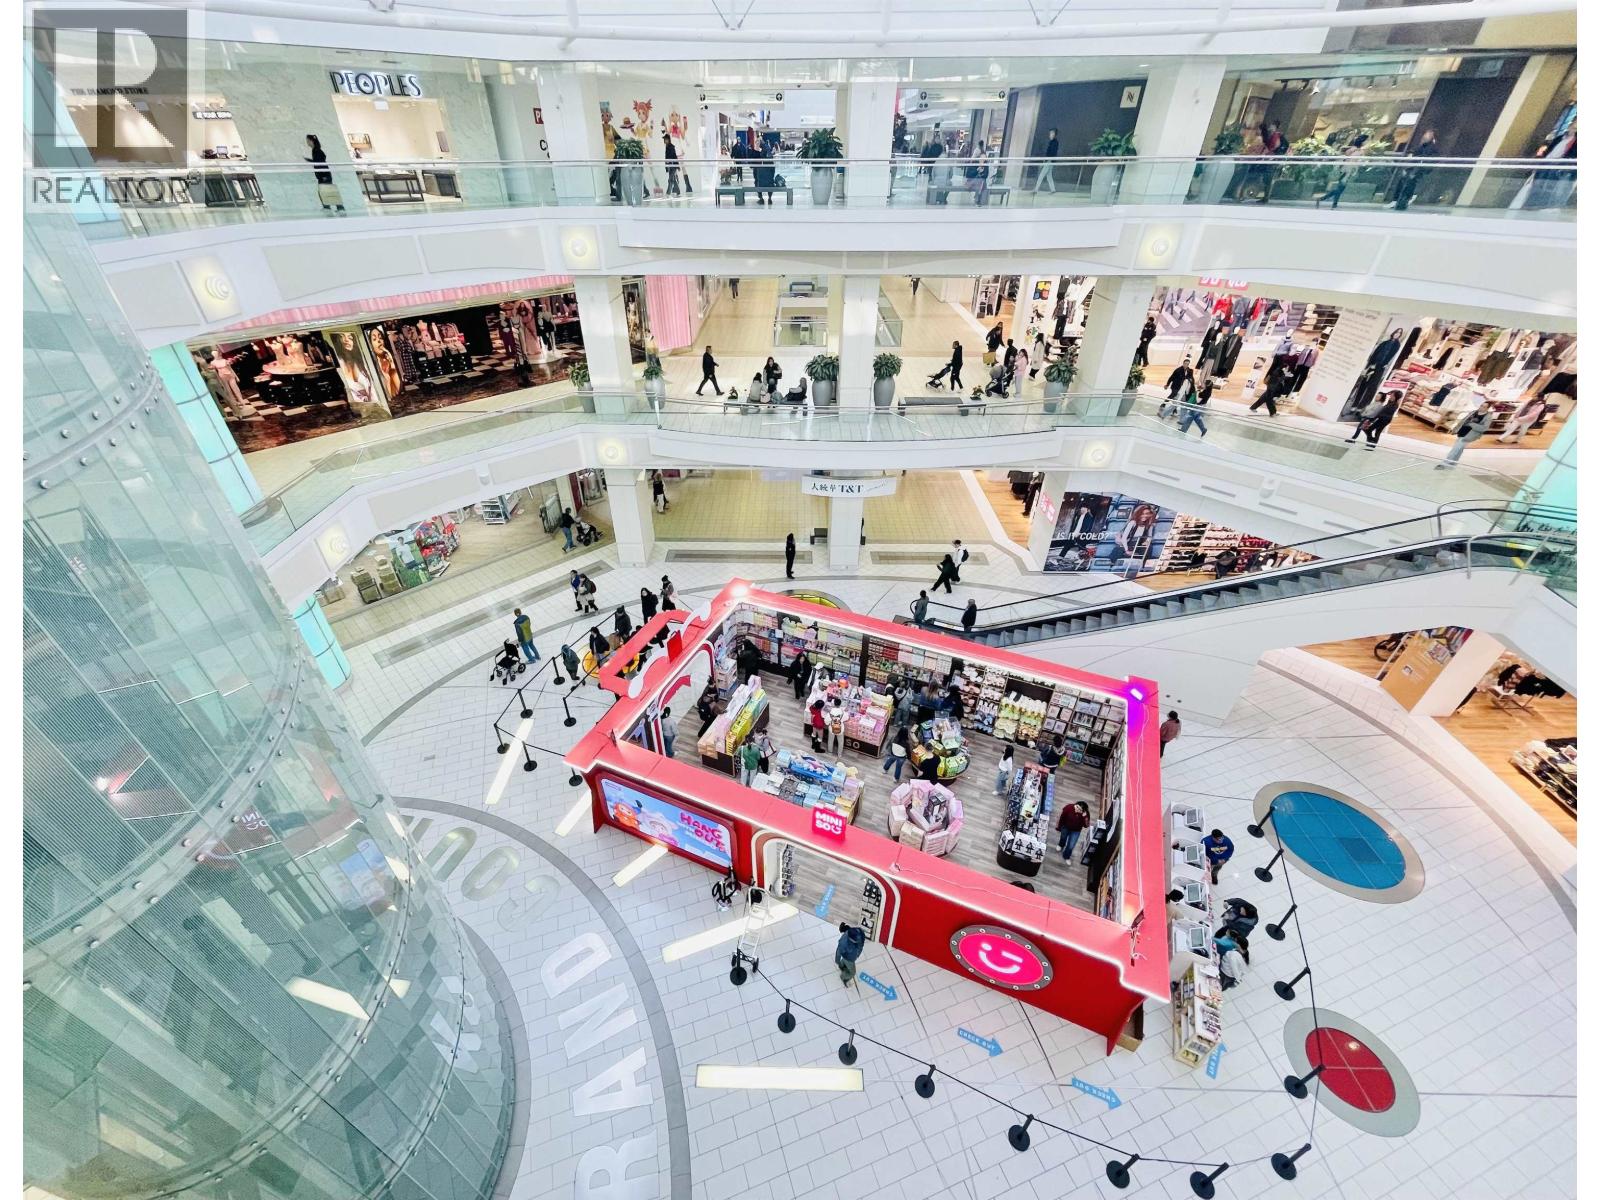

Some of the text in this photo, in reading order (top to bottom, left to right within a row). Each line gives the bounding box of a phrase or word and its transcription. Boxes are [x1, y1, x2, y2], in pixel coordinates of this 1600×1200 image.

[329, 71, 421, 97] PEOPLES
[838, 484, 864, 494] T&T
[1080, 532, 1109, 540] COLD?
[815, 811, 843, 827] MINI
[959, 1029, 996, 1051] CHECK OUT
[1074, 1080, 1117, 1104] CHECK OUT
